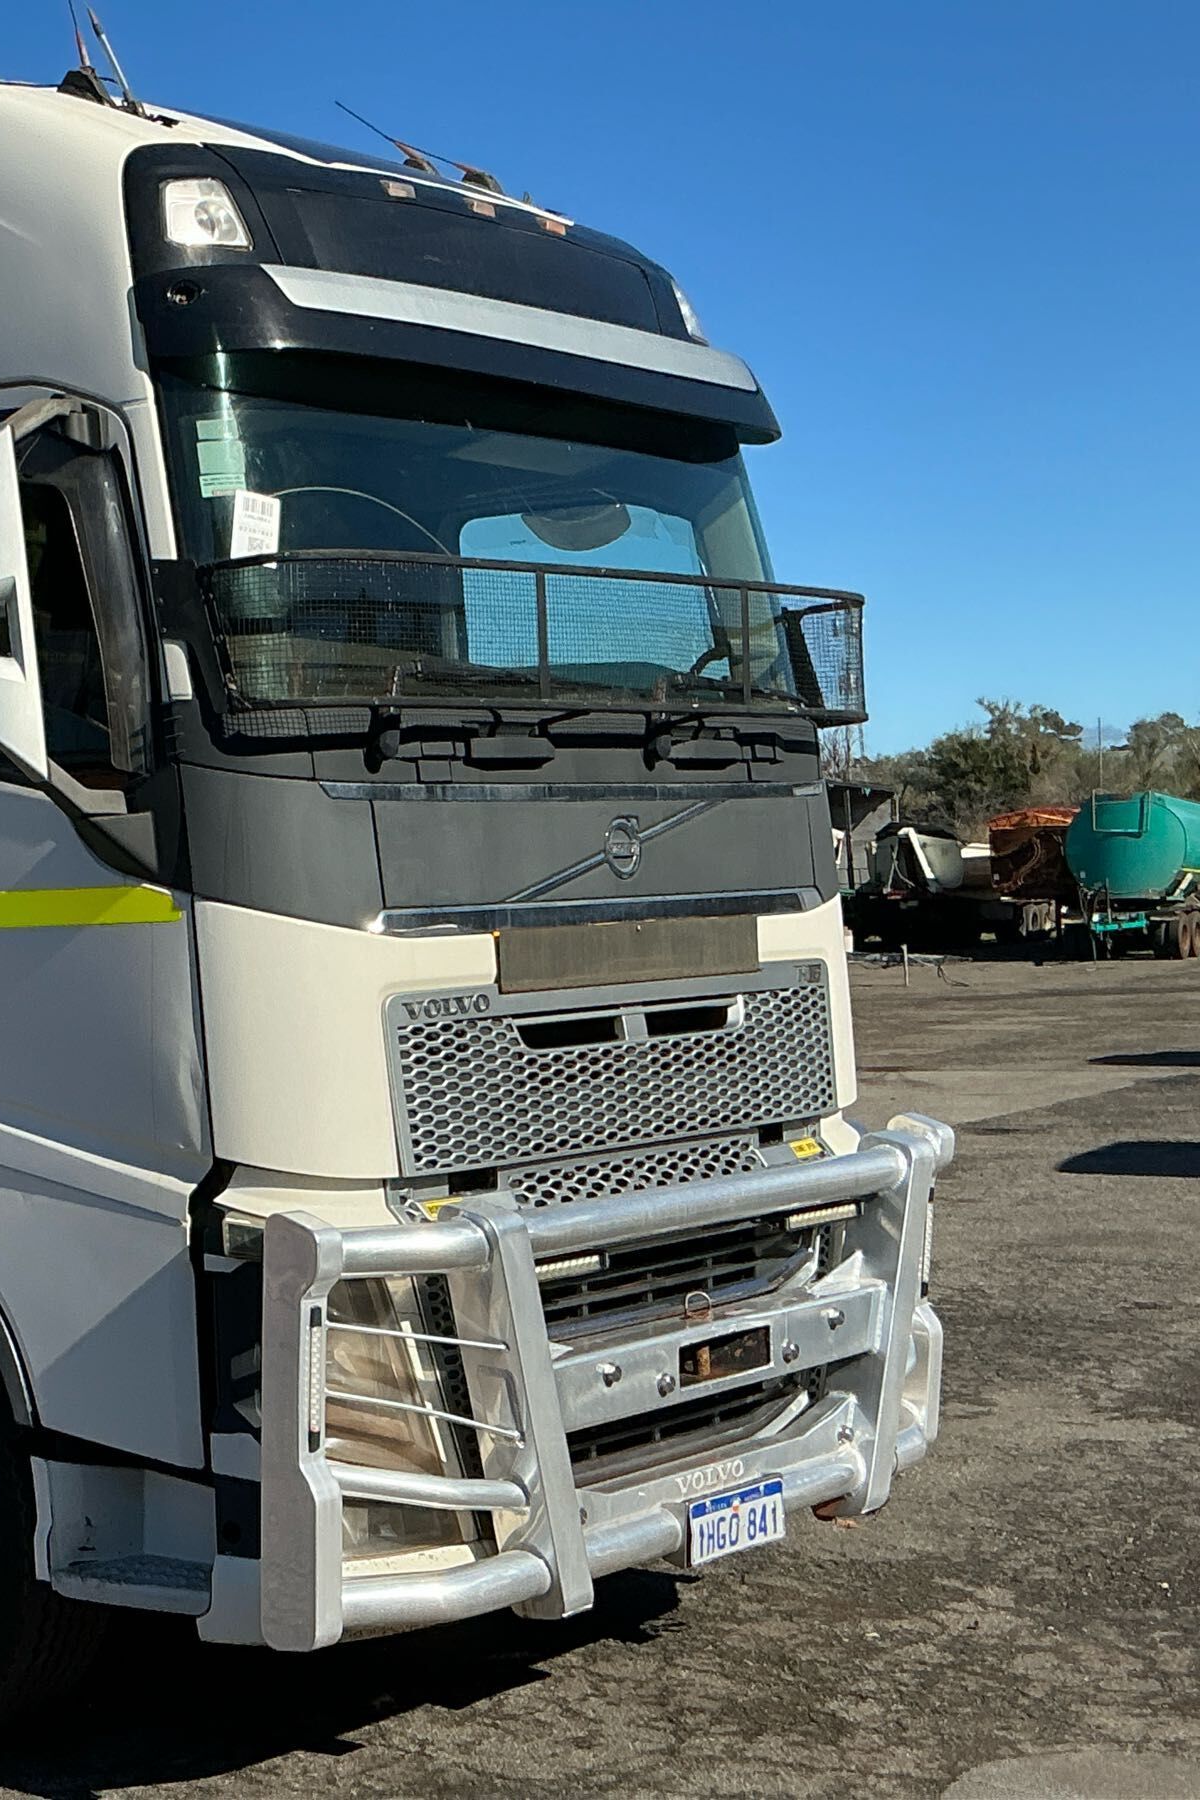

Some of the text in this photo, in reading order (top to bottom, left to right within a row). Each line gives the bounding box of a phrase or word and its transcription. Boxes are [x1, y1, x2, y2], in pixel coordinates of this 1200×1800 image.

[401, 993, 491, 1021] VOLVO
[675, 1459, 745, 1494] VOLVO
[747, 1500, 779, 1541] 841
